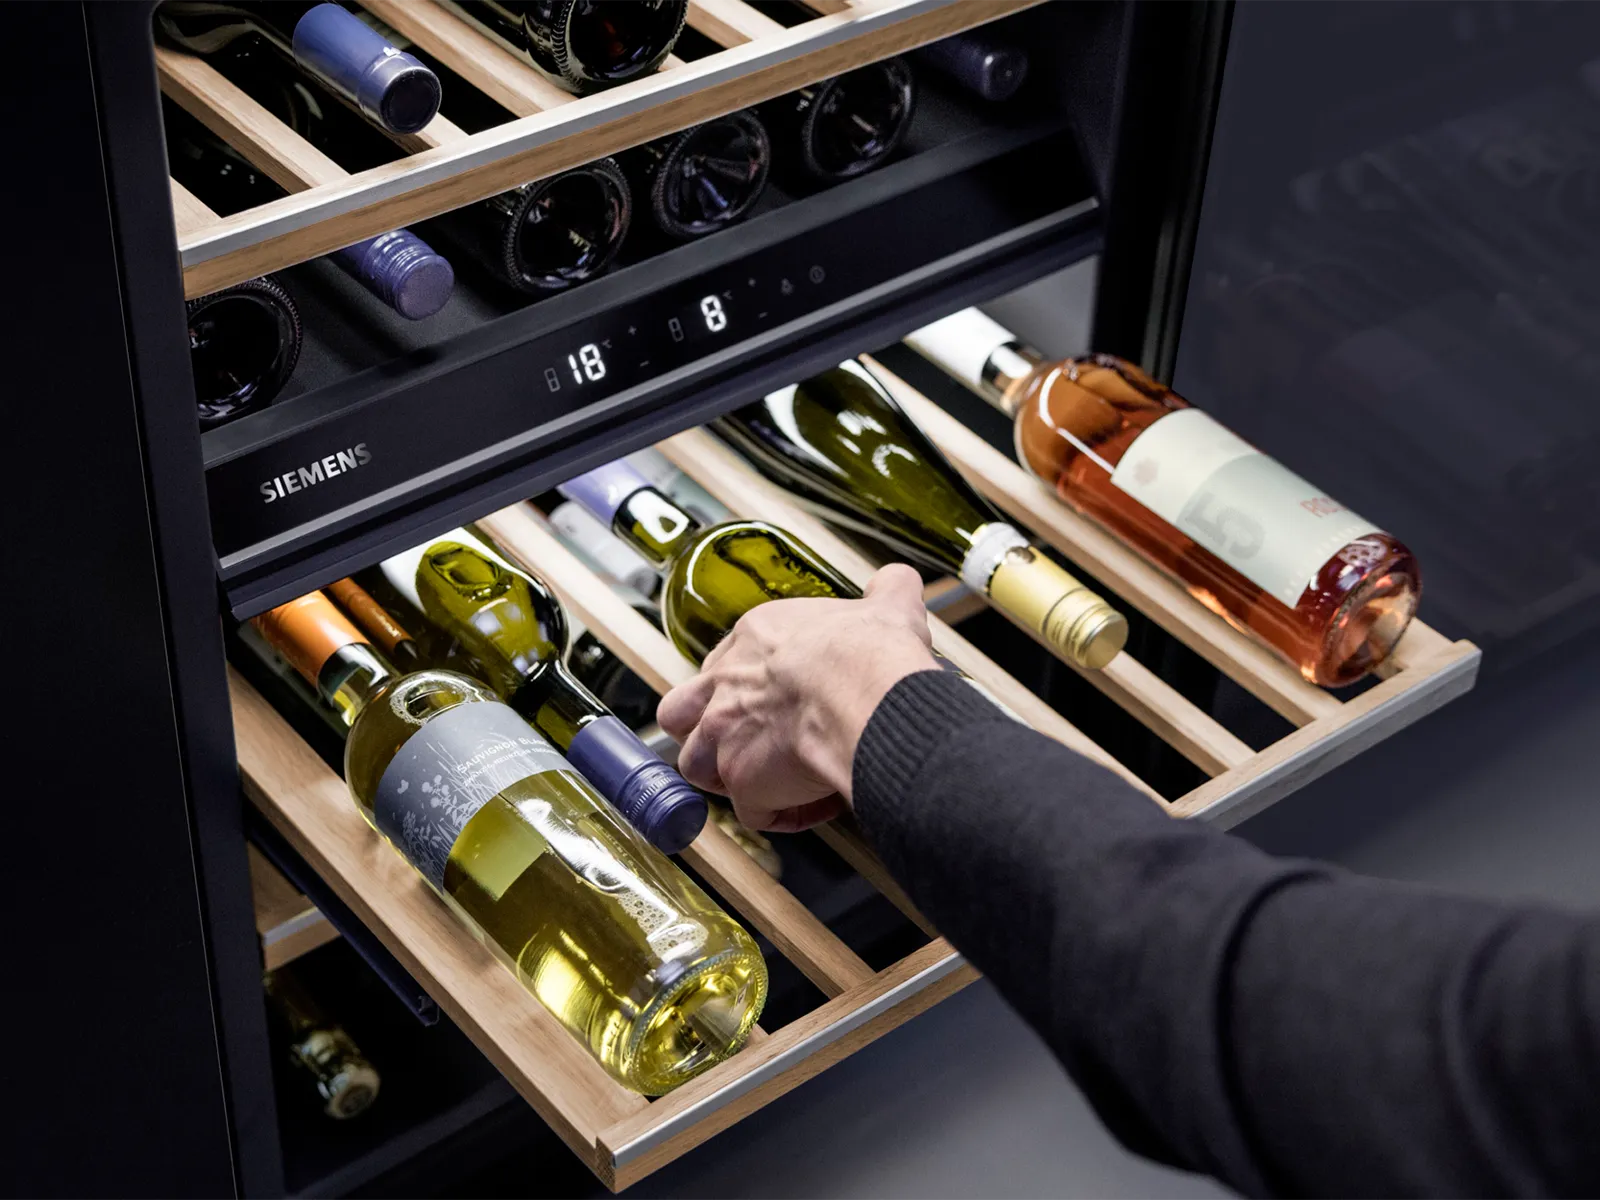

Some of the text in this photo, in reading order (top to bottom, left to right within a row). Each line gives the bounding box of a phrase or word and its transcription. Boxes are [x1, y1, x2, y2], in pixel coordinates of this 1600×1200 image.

[699, 294, 727, 332] 8
[567, 343, 607, 385] 18
[259, 442, 372, 504] SIEMENS
[1184, 491, 1265, 560] 5
[456, 739, 517, 774] SAUVIGNON
